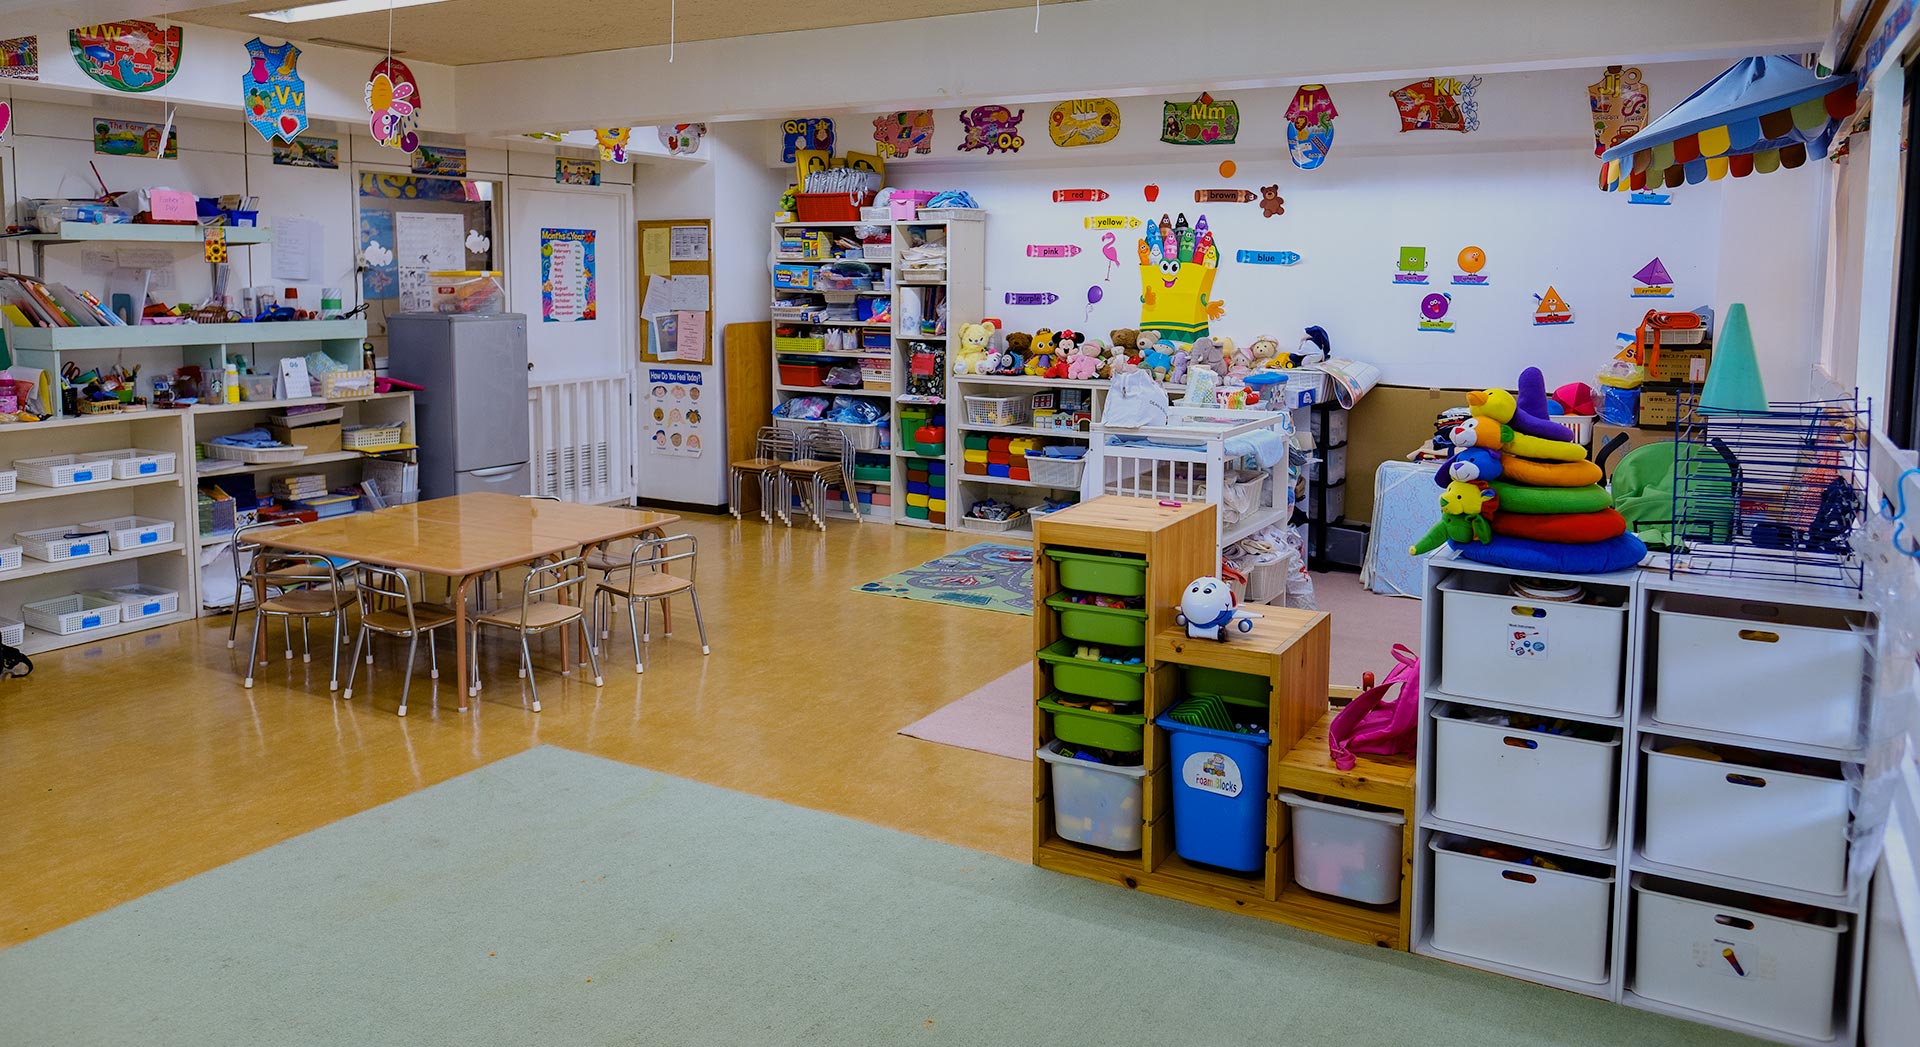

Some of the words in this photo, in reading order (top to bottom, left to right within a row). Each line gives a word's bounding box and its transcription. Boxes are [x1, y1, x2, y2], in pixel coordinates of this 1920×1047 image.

[1433, 78, 1462, 96] Kk
[275, 85, 304, 106] Vv
[1072, 99, 1096, 114] Nn
[1191, 104, 1226, 121] Mm
[109, 121, 123, 131] The
[125, 123, 144, 132] Farm
[785, 121, 807, 135] Qq
[998, 132, 1023, 149] Oo
[876, 142, 896, 158] Pp
[1210, 191, 1236, 199] brown
[1097, 218, 1123, 228] yellow
[541, 231, 565, 239] Months
[570, 232, 585, 240] Year
[1043, 247, 1059, 257] pink
[1257, 253, 1275, 262] blue
[1018, 295, 1041, 304] purple
[651, 371, 660, 380] How
[661, 372, 668, 380] Do
[668, 372, 676, 380] You
[1196, 773, 1213, 787] Foam
[1215, 778, 1238, 793] Blocks
